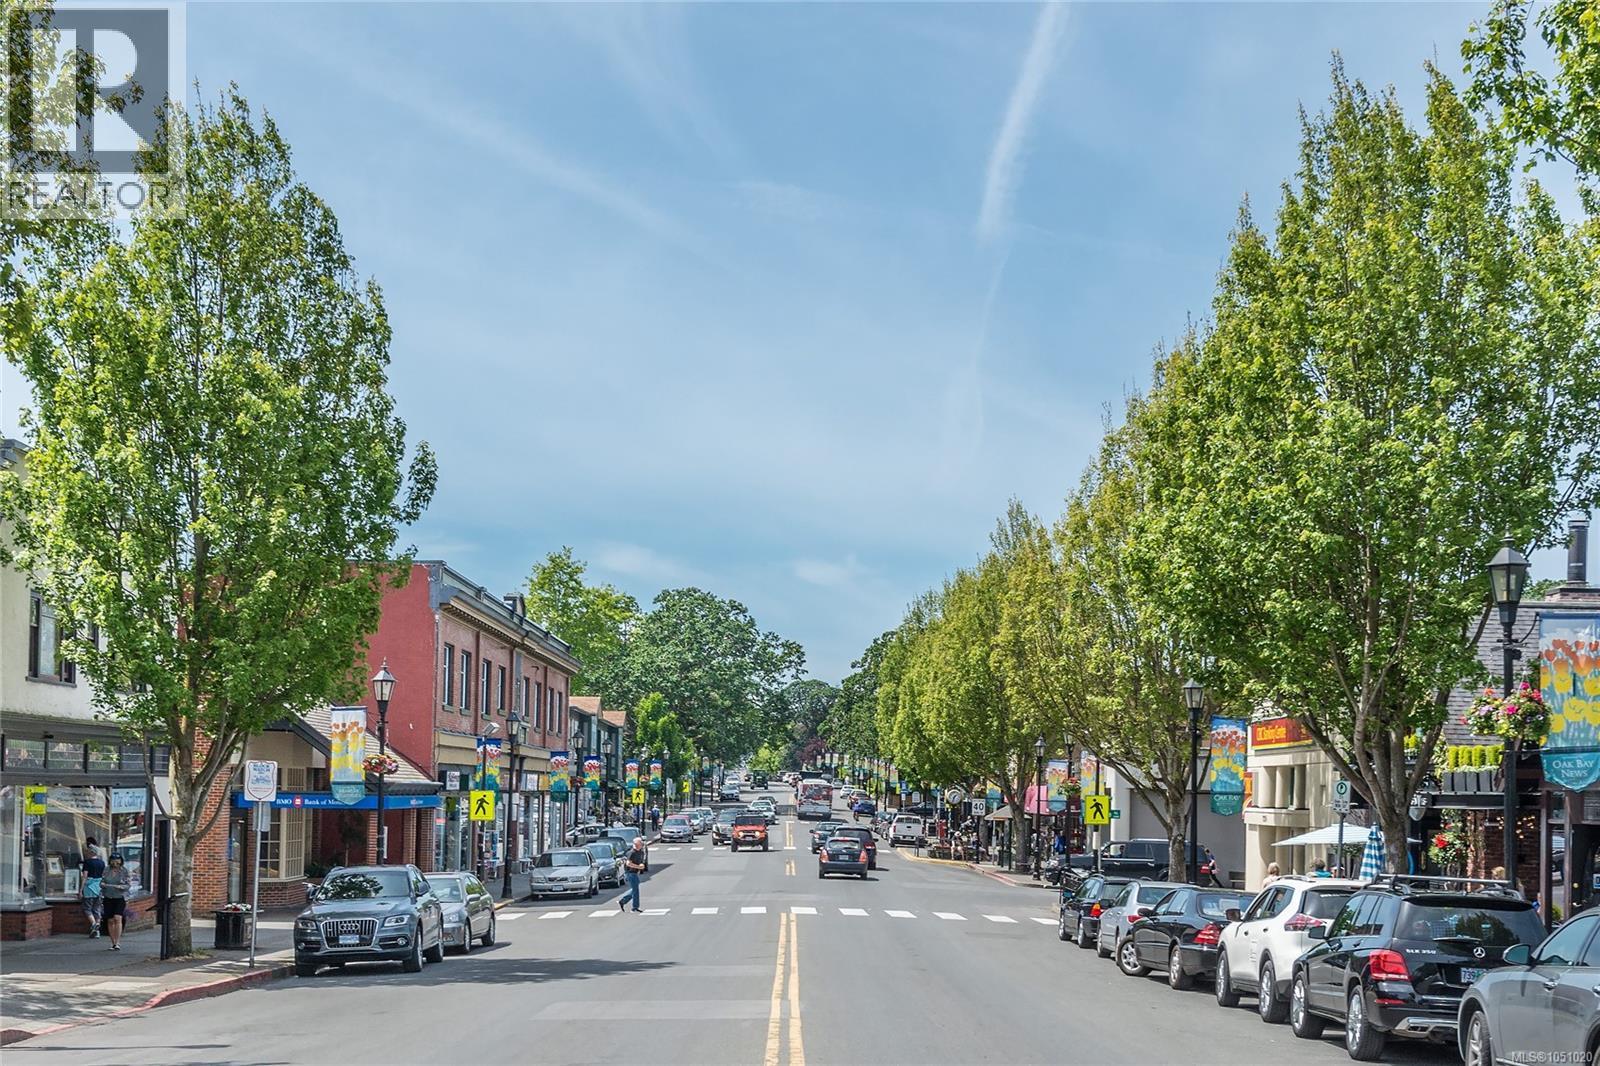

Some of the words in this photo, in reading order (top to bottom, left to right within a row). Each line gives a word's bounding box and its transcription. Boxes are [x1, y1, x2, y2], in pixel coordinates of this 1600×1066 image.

[1552, 760, 1574, 769] OAK
[1576, 759, 1594, 768] BAY
[1561, 769, 1588, 778] NEWS
